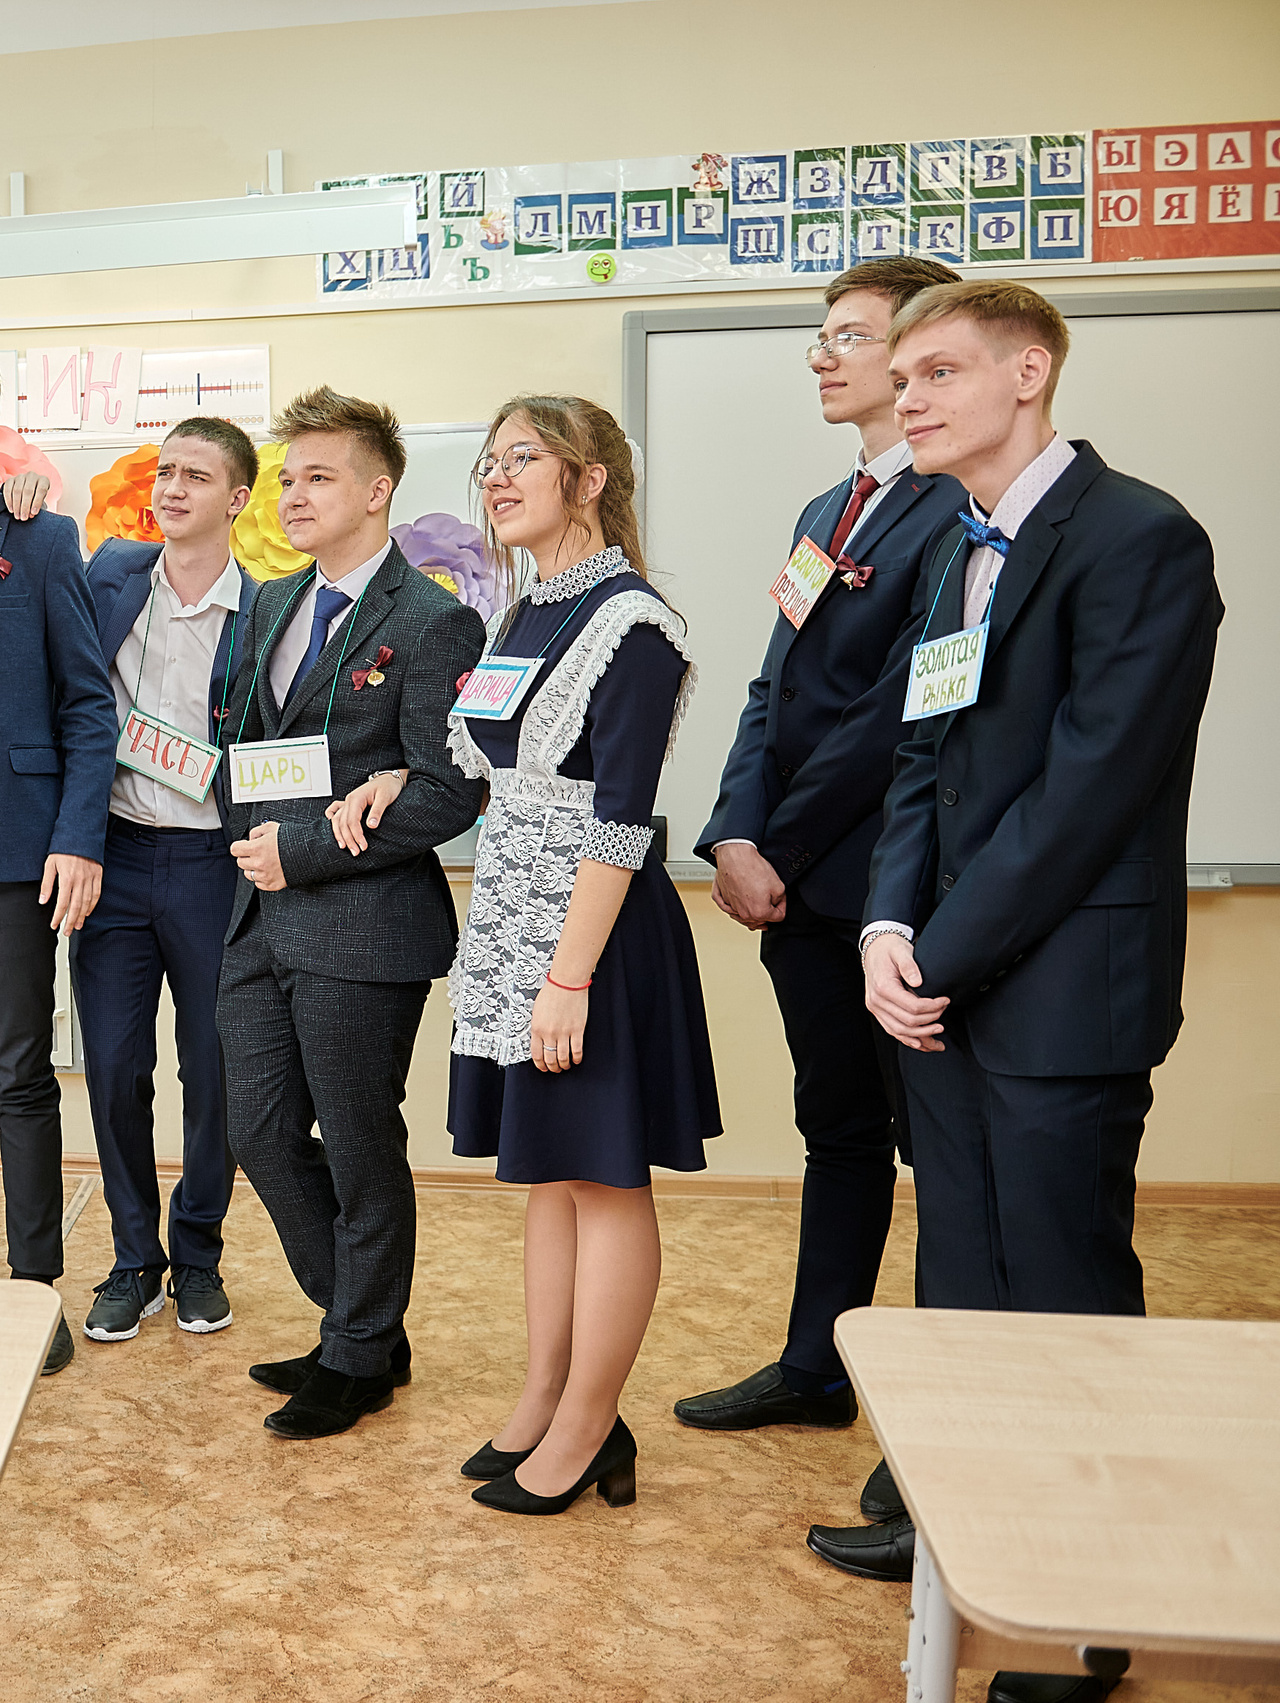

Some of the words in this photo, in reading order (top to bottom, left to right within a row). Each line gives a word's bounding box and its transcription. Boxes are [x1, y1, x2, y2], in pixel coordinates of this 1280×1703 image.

[1102, 139, 1137, 167] Ы
[1164, 140, 1189, 167] Э
[1215, 137, 1245, 165] А
[742, 168, 778, 197] Ж
[809, 166, 831, 193] З
[862, 160, 891, 193] Д
[927, 156, 950, 183] Г
[982, 155, 1008, 182] В
[1046, 151, 1072, 179] Б
[449, 176, 478, 209] Й
[1099, 194, 1139, 223] Ю
[1160, 192, 1189, 220] Я
[1217, 185, 1242, 218] Ё
[524, 212, 552, 238] Л
[576, 209, 608, 235] М
[632, 204, 661, 231] Н
[691, 203, 716, 229] Р
[806, 228, 830, 255] С
[867, 224, 892, 251] Т
[926, 222, 955, 249] К
[982, 215, 1016, 244] Ф
[1044, 215, 1074, 242] П
[462, 256, 491, 282] Ъ
[459, 674, 520, 707] ЦАРИЦА
[126, 713, 218, 787] ЧАСЫ
[237, 757, 306, 792] ЦАРЬ
